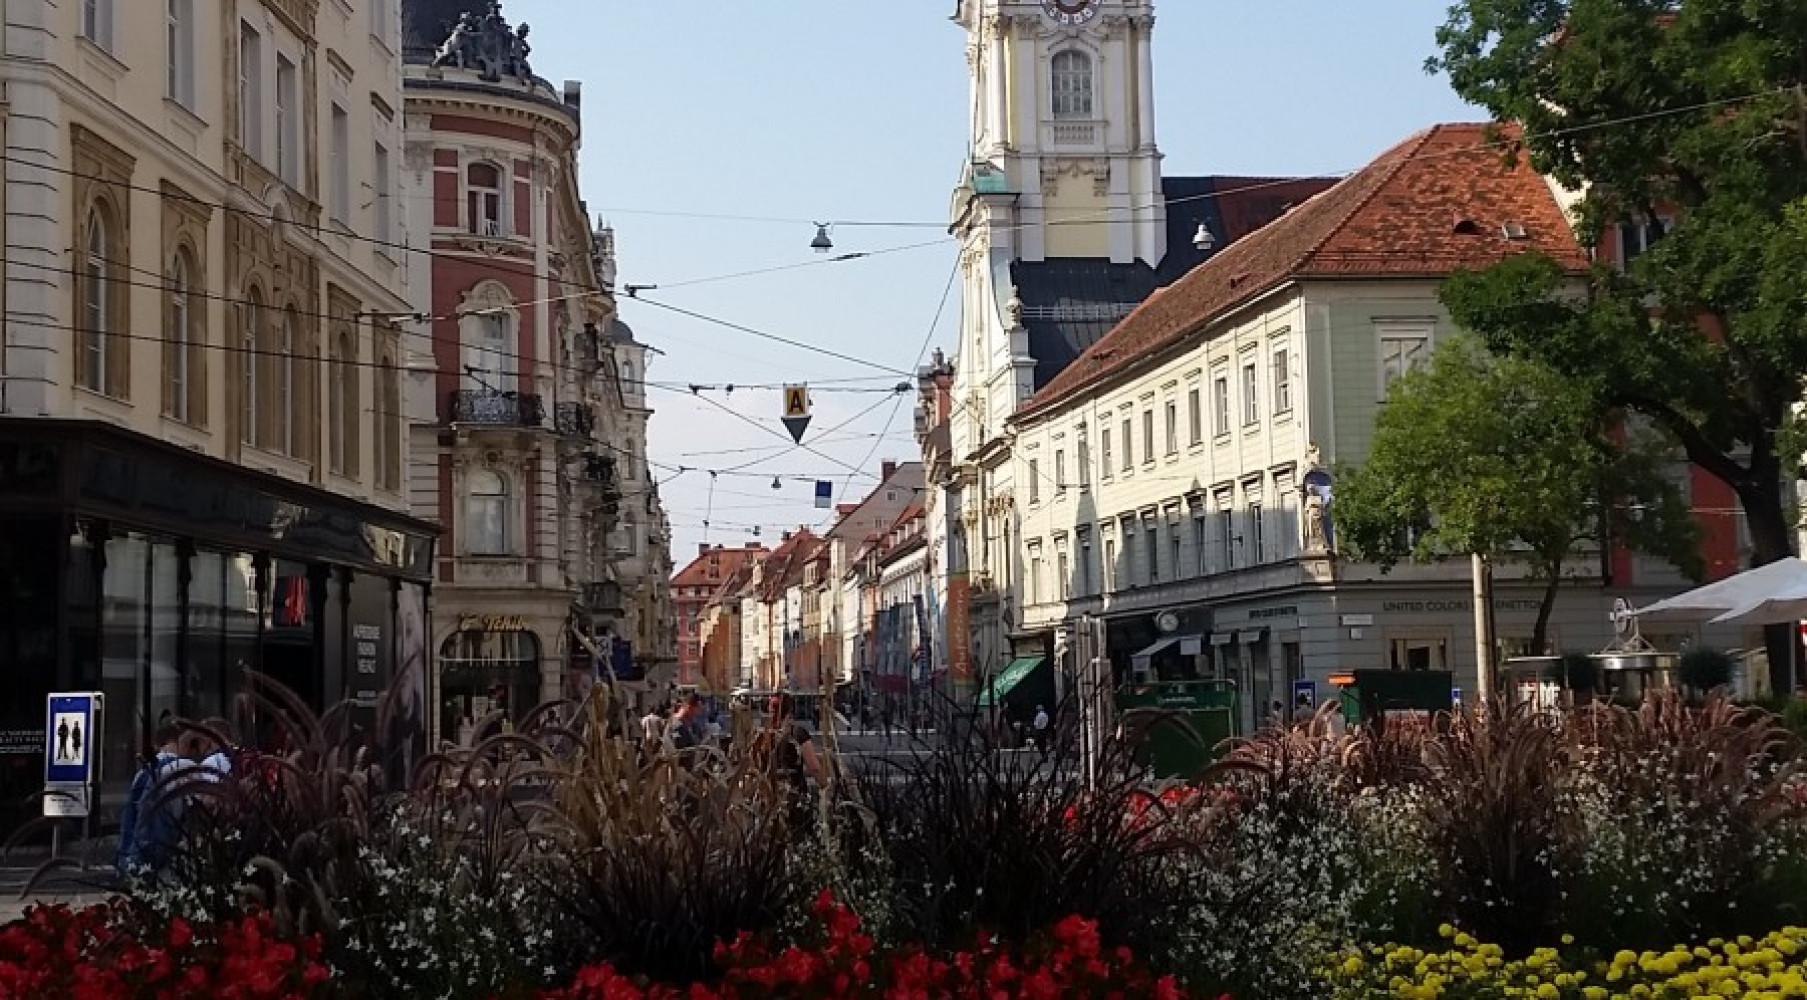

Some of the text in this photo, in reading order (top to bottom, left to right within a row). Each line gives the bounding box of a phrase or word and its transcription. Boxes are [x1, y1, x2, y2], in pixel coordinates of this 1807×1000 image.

[787, 389, 805, 414] A
[1382, 600, 1424, 612] UNITED
[1426, 600, 1470, 612] COLORS
